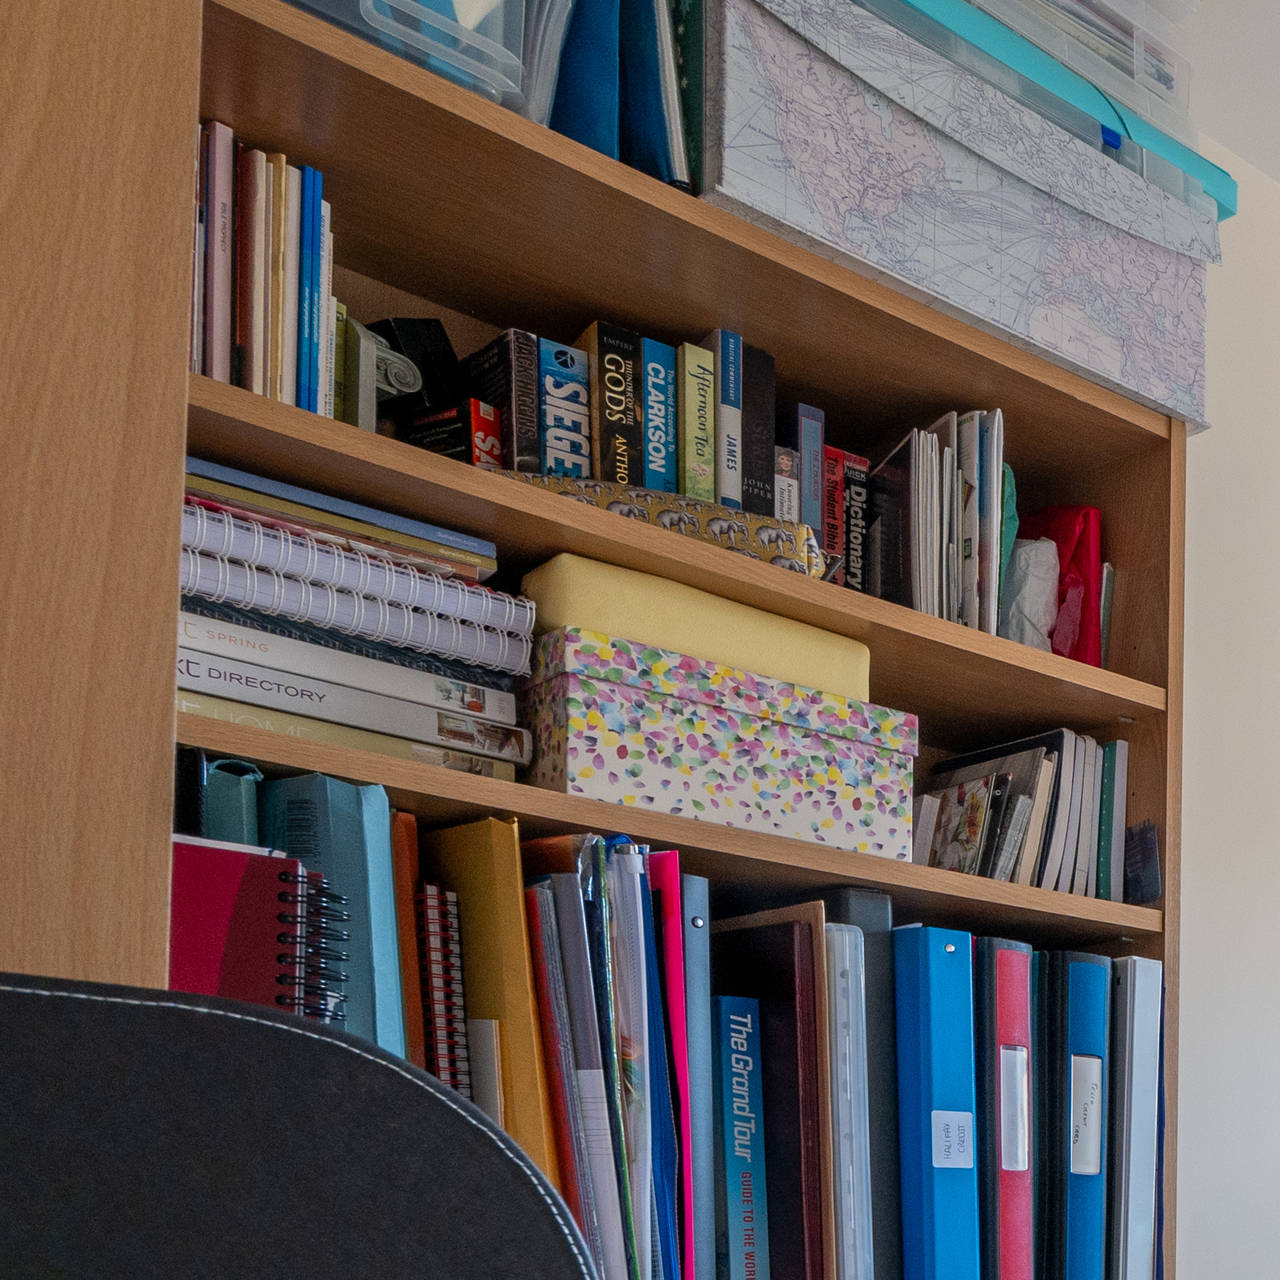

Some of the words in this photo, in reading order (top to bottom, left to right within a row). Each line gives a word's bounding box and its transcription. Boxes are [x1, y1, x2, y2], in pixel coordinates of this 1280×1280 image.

[516, 337, 536, 377] JACK
[667, 369, 675, 383] The
[604, 353, 626, 424] GODS
[624, 360, 633, 398] THUNDER
[667, 384, 675, 405] World
[687, 364, 714, 431] Afternoon
[517, 376, 536, 439] HIGGINS
[544, 374, 590, 478] SIEGE
[647, 362, 666, 473] CLARKSON
[666, 406, 675, 442] According
[694, 435, 709, 458] Tea
[726, 434, 738, 472] JAMES
[743, 477, 772, 490] JOHN
[825, 478, 839, 520] Student
[826, 523, 839, 551] Bible
[847, 485, 867, 590] Dictionary
[206, 629, 270, 654] SPRING
[207, 666, 327, 704] DIRECTORY
[729, 1013, 752, 1052] The
[731, 1053, 756, 1118] Grand
[733, 1119, 756, 1163] Tour
[741, 1171, 754, 1206] GUIDE
[742, 1208, 755, 1223] TO
[743, 1227, 755, 1248] THE
